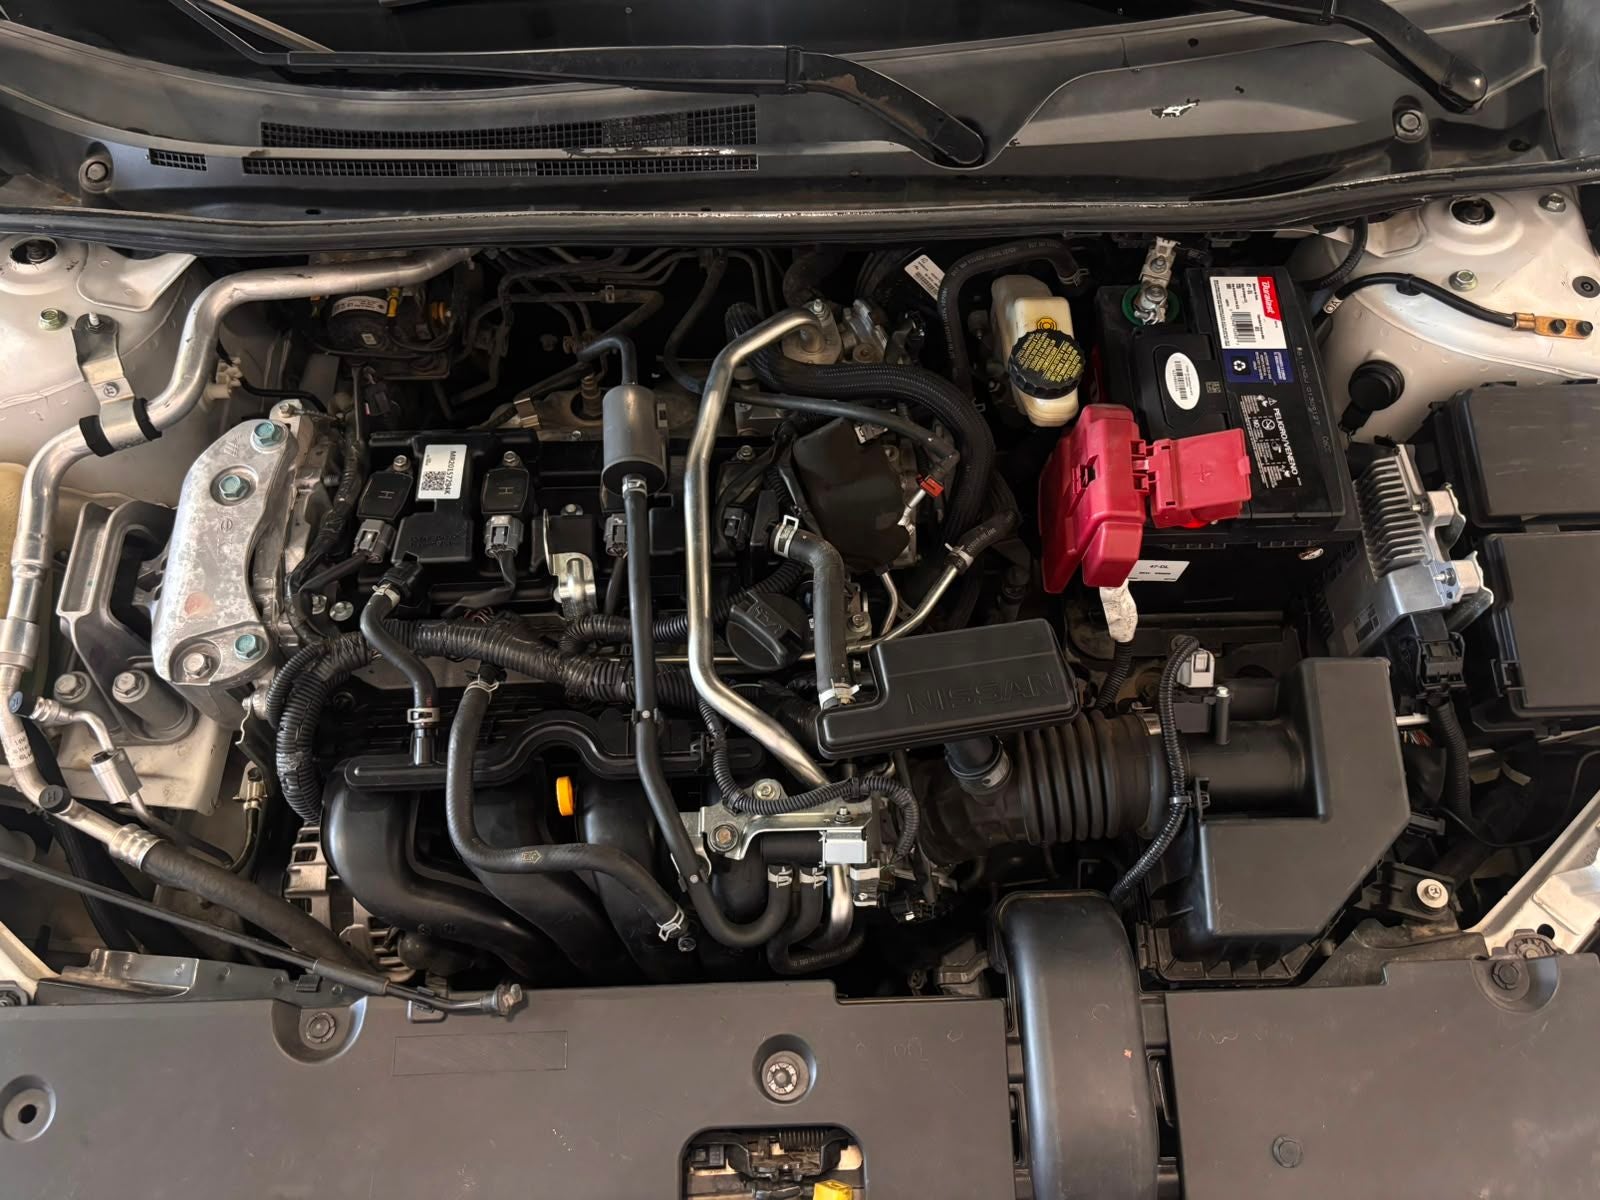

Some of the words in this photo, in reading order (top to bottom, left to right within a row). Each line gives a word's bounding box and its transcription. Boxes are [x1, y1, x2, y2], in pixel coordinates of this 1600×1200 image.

[1261, 281, 1275, 314] Duralast
[1273, 407, 1299, 475] PELIGRO/VENENO
[907, 671, 1056, 714] NISSAN
